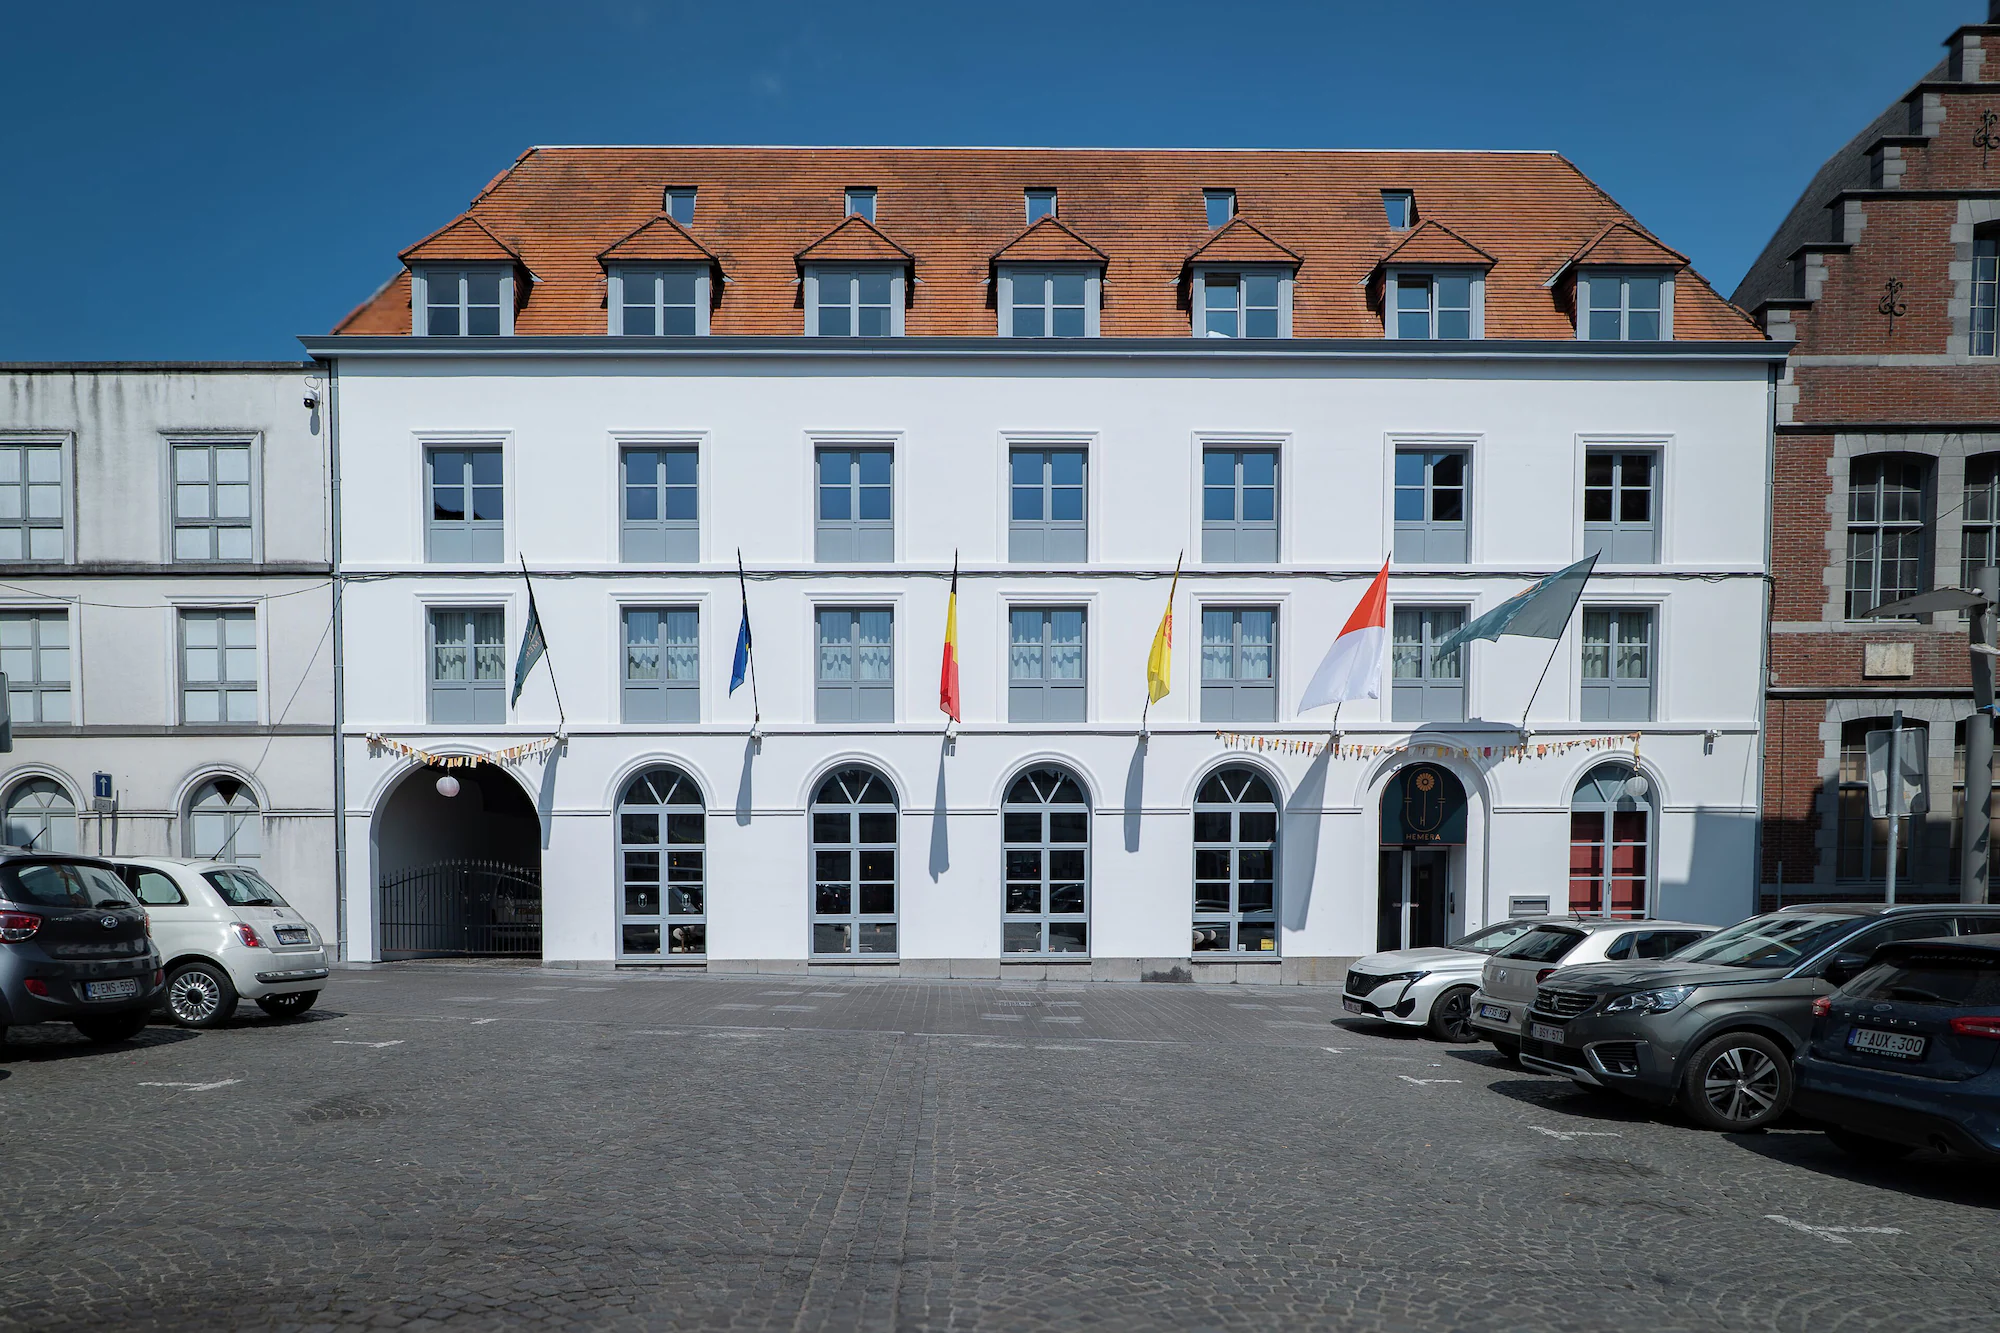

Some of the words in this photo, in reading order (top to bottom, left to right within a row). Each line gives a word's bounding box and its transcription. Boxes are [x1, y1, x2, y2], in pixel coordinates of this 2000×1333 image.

[1405, 833, 1441, 841] HEMERA
[91, 980, 136, 995] 2-ENS-555
[1856, 1030, 1923, 1053] 1-AUX-300
[1880, 1050, 1907, 1059] MOTORS
